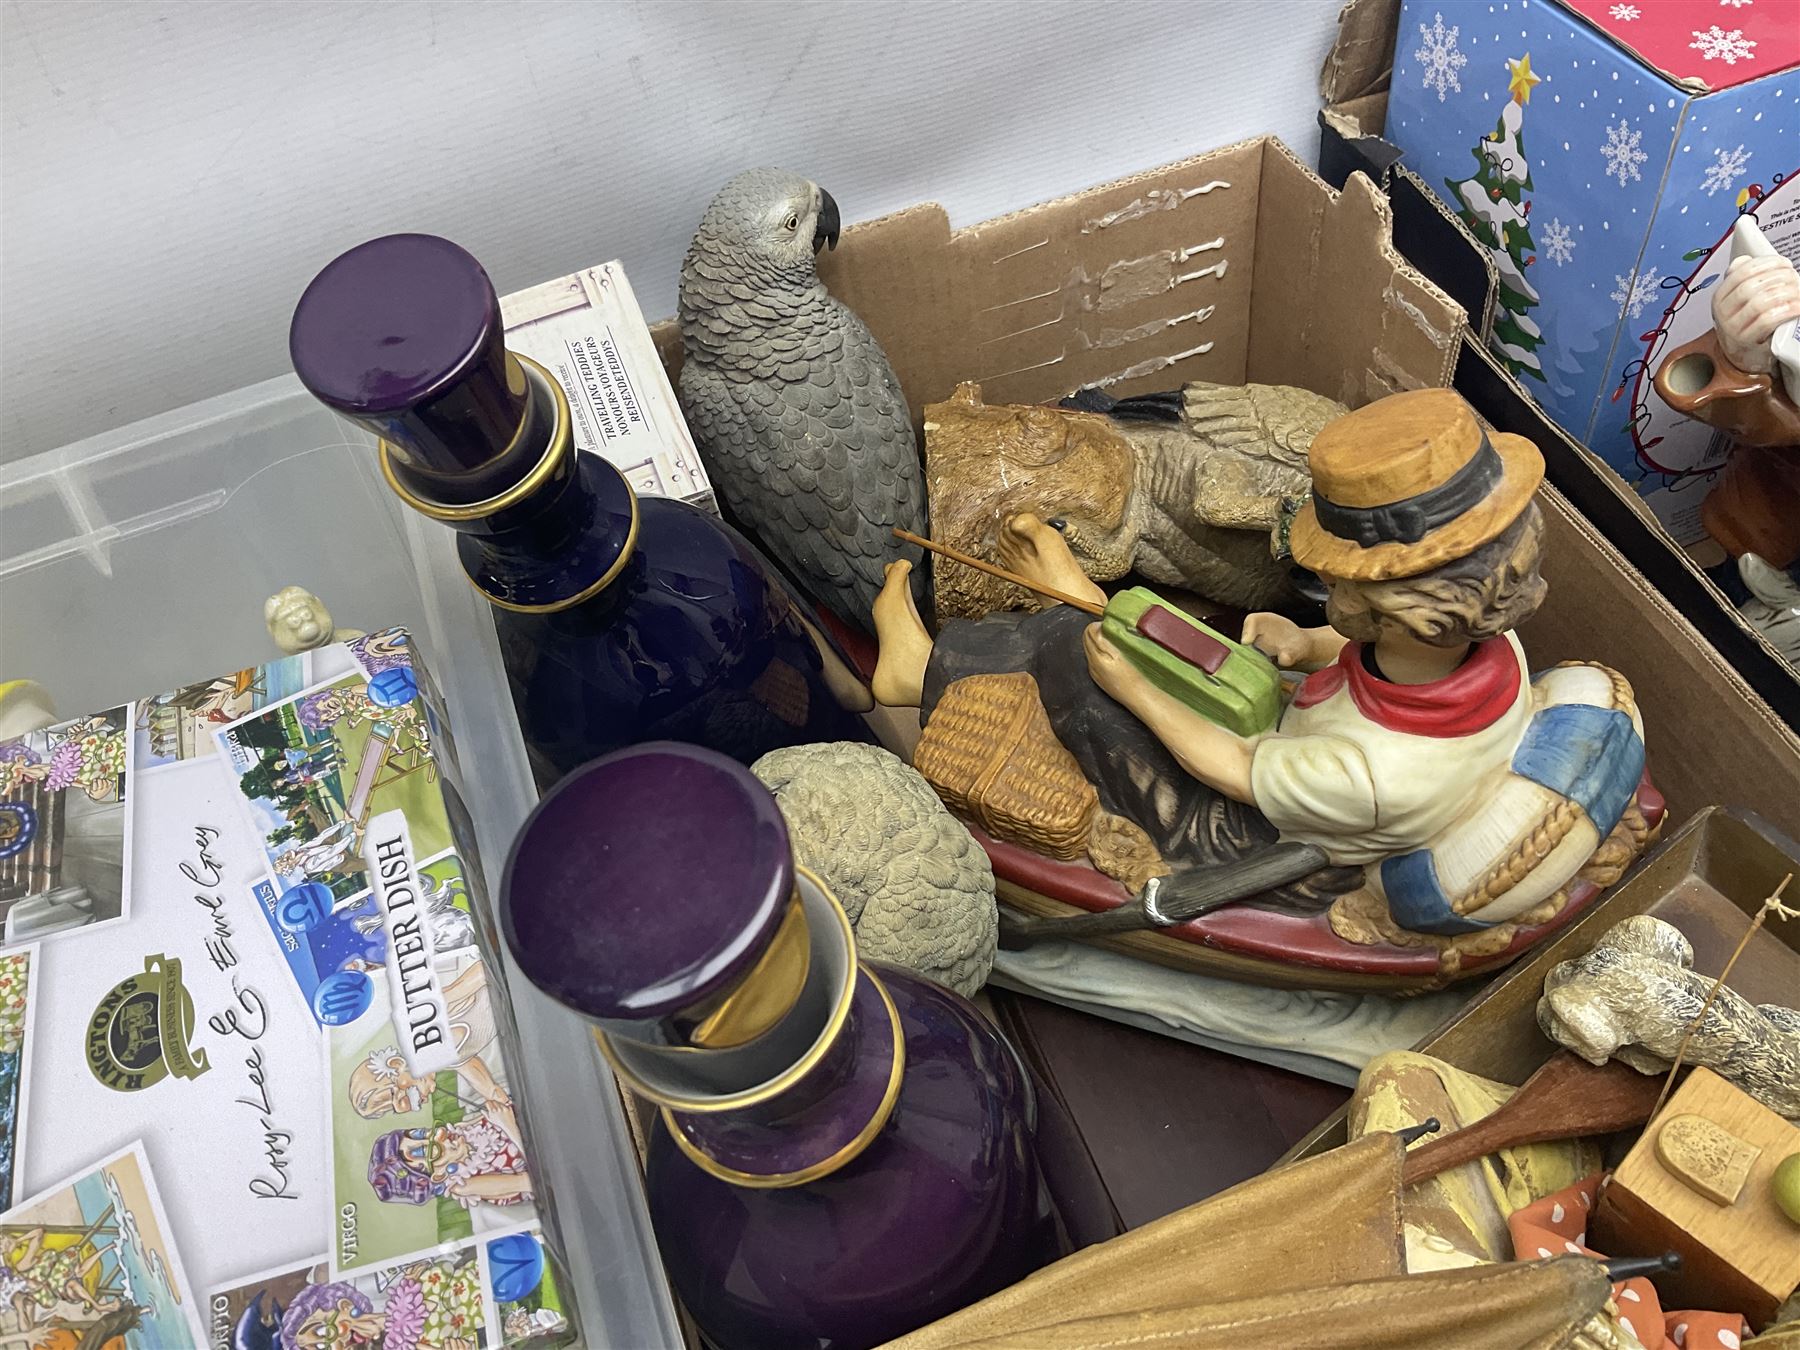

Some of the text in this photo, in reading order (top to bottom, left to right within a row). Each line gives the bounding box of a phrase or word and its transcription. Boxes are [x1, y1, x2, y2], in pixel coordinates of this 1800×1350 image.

[571, 341, 617, 440] TRAVELLING TEDDIES
[601, 340, 641, 422] REISENDETEDDYS
[179, 826, 222, 888] Grey
[195, 895, 237, 972] Earl
[376, 834, 443, 1054] BUTTER DISH
[166, 978, 176, 1002] SINCE
[166, 1002, 177, 1041] BUSINESS
[90, 978, 145, 1089] RINGTONS
[170, 1040, 187, 1065] FAMILY
[341, 1202, 358, 1265] VIRGO
